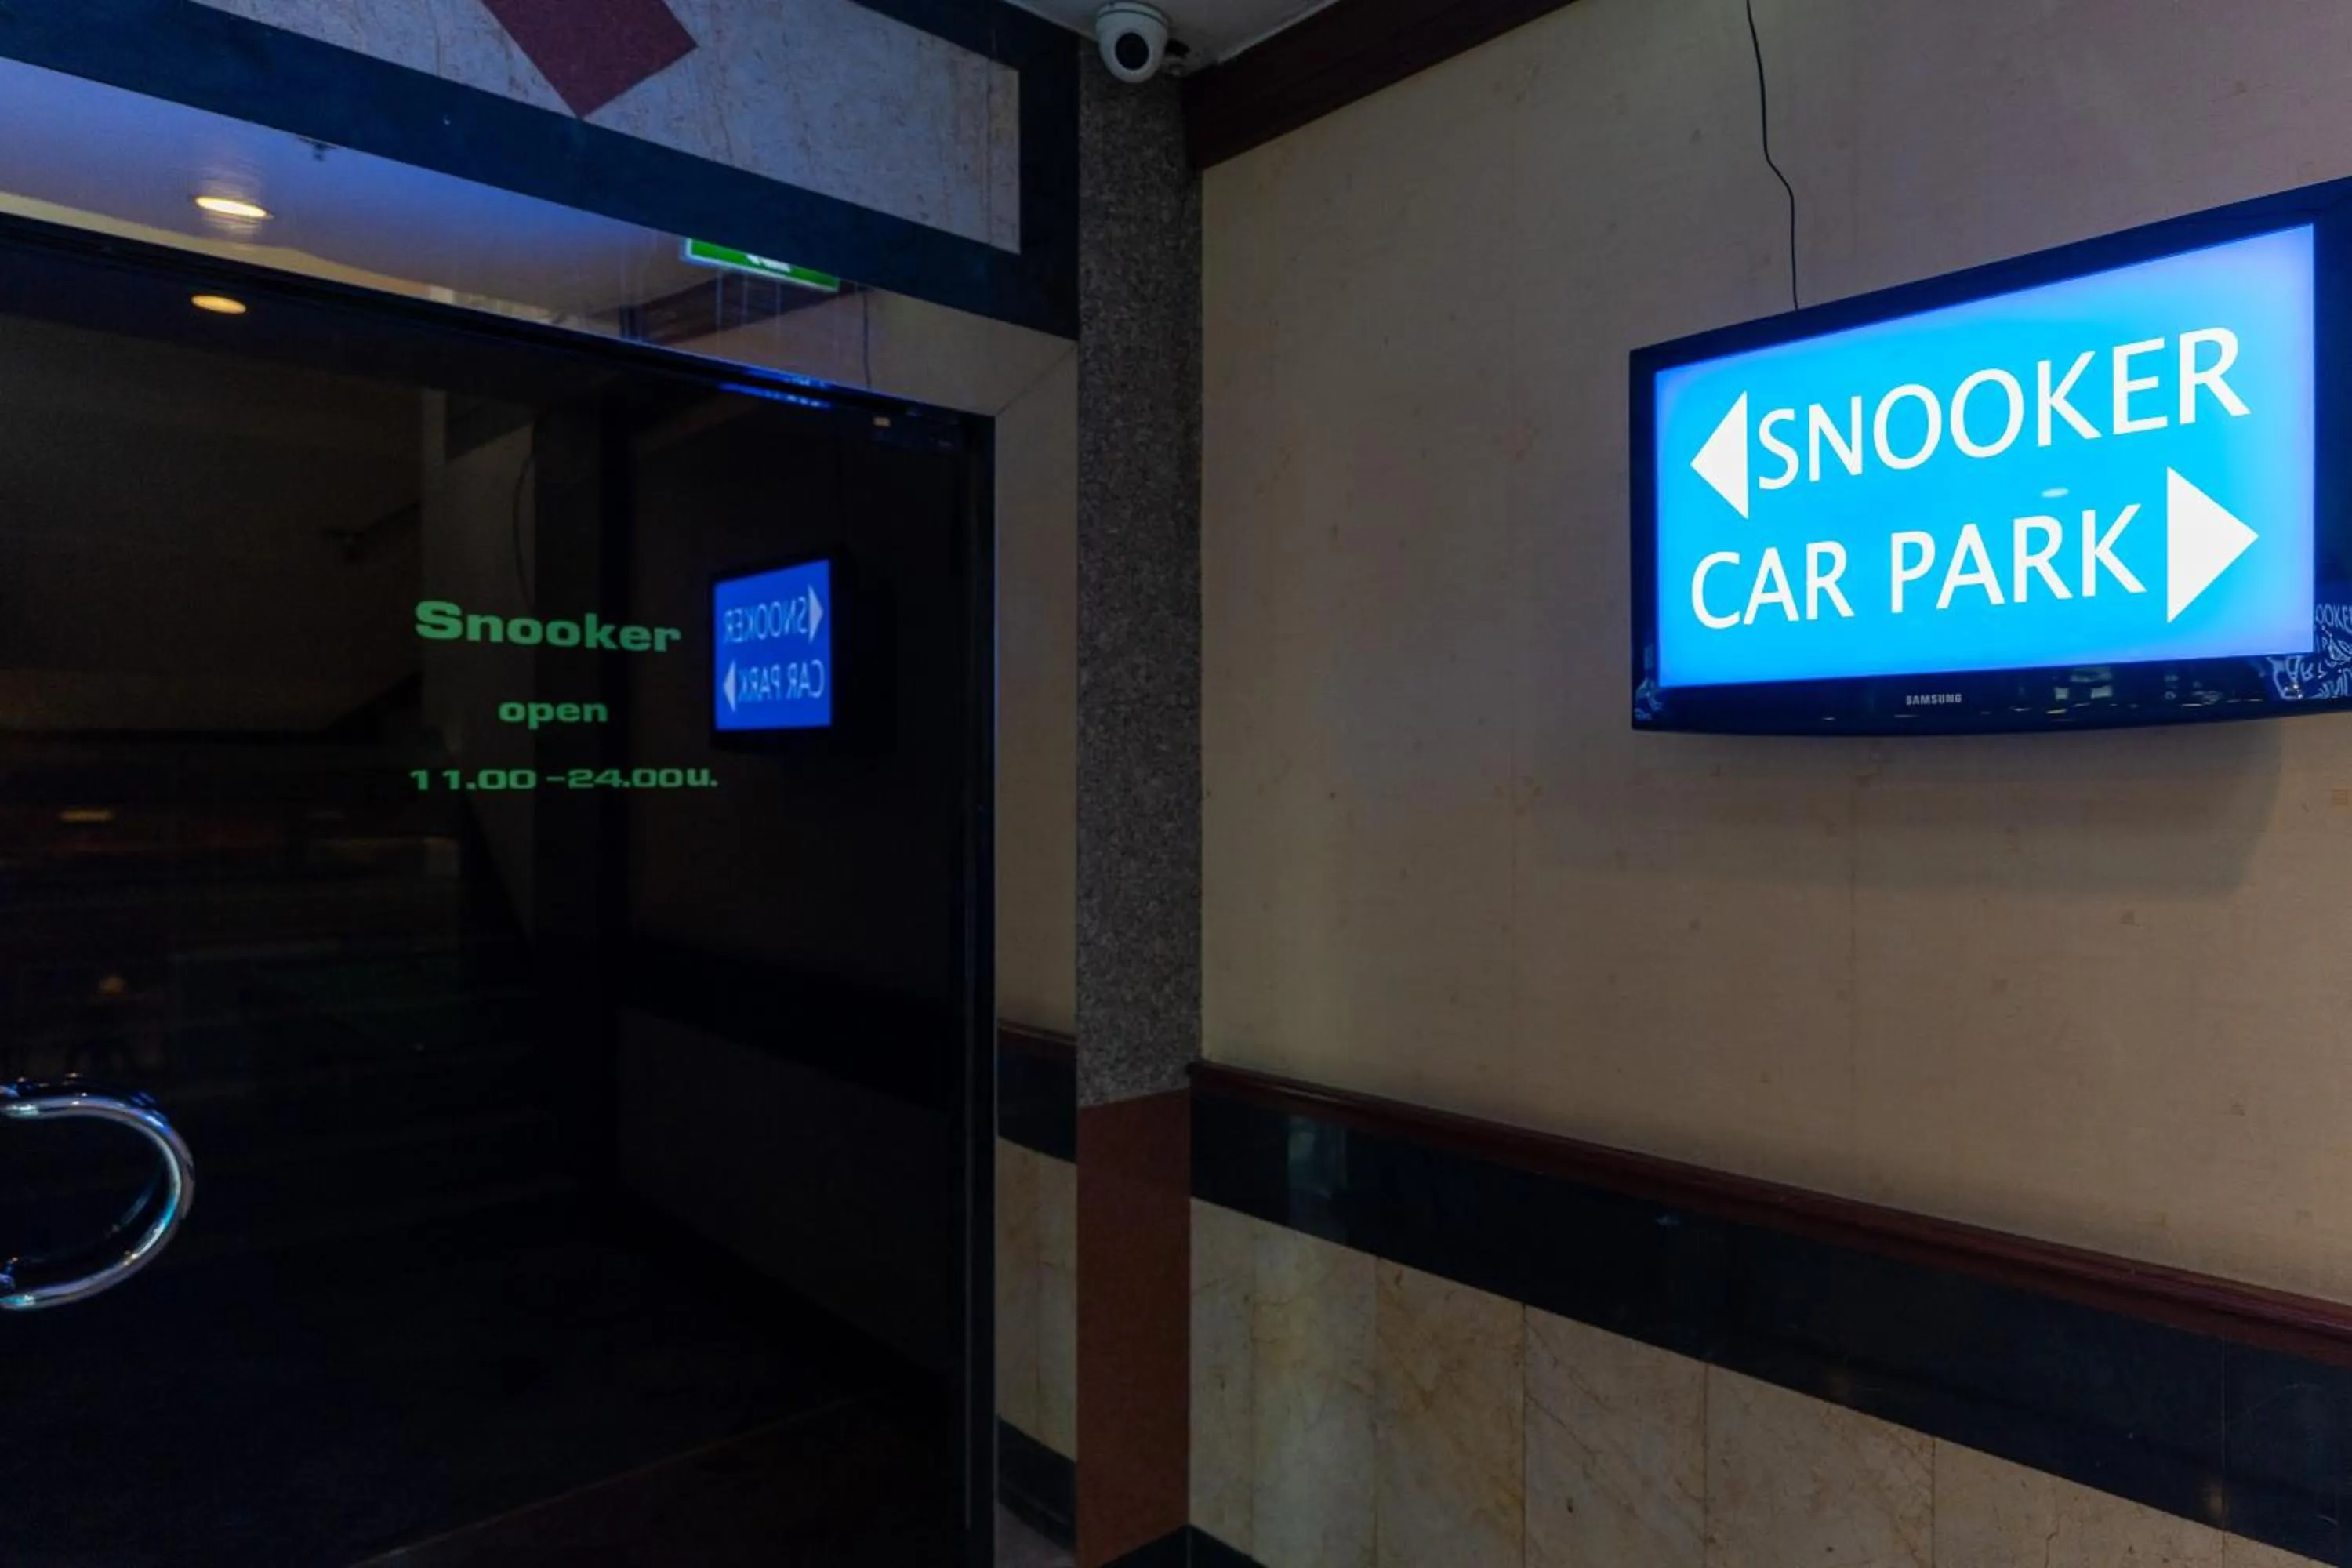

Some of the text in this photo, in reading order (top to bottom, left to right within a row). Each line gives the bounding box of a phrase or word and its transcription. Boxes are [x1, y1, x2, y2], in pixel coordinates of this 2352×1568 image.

[1758, 327, 2251, 490] SNOOKER
[1691, 503, 2147, 629] CAR PARK
[415, 600, 681, 652] Snooker
[498, 702, 608, 729] open
[1906, 693, 1962, 706] SAMSUNG
